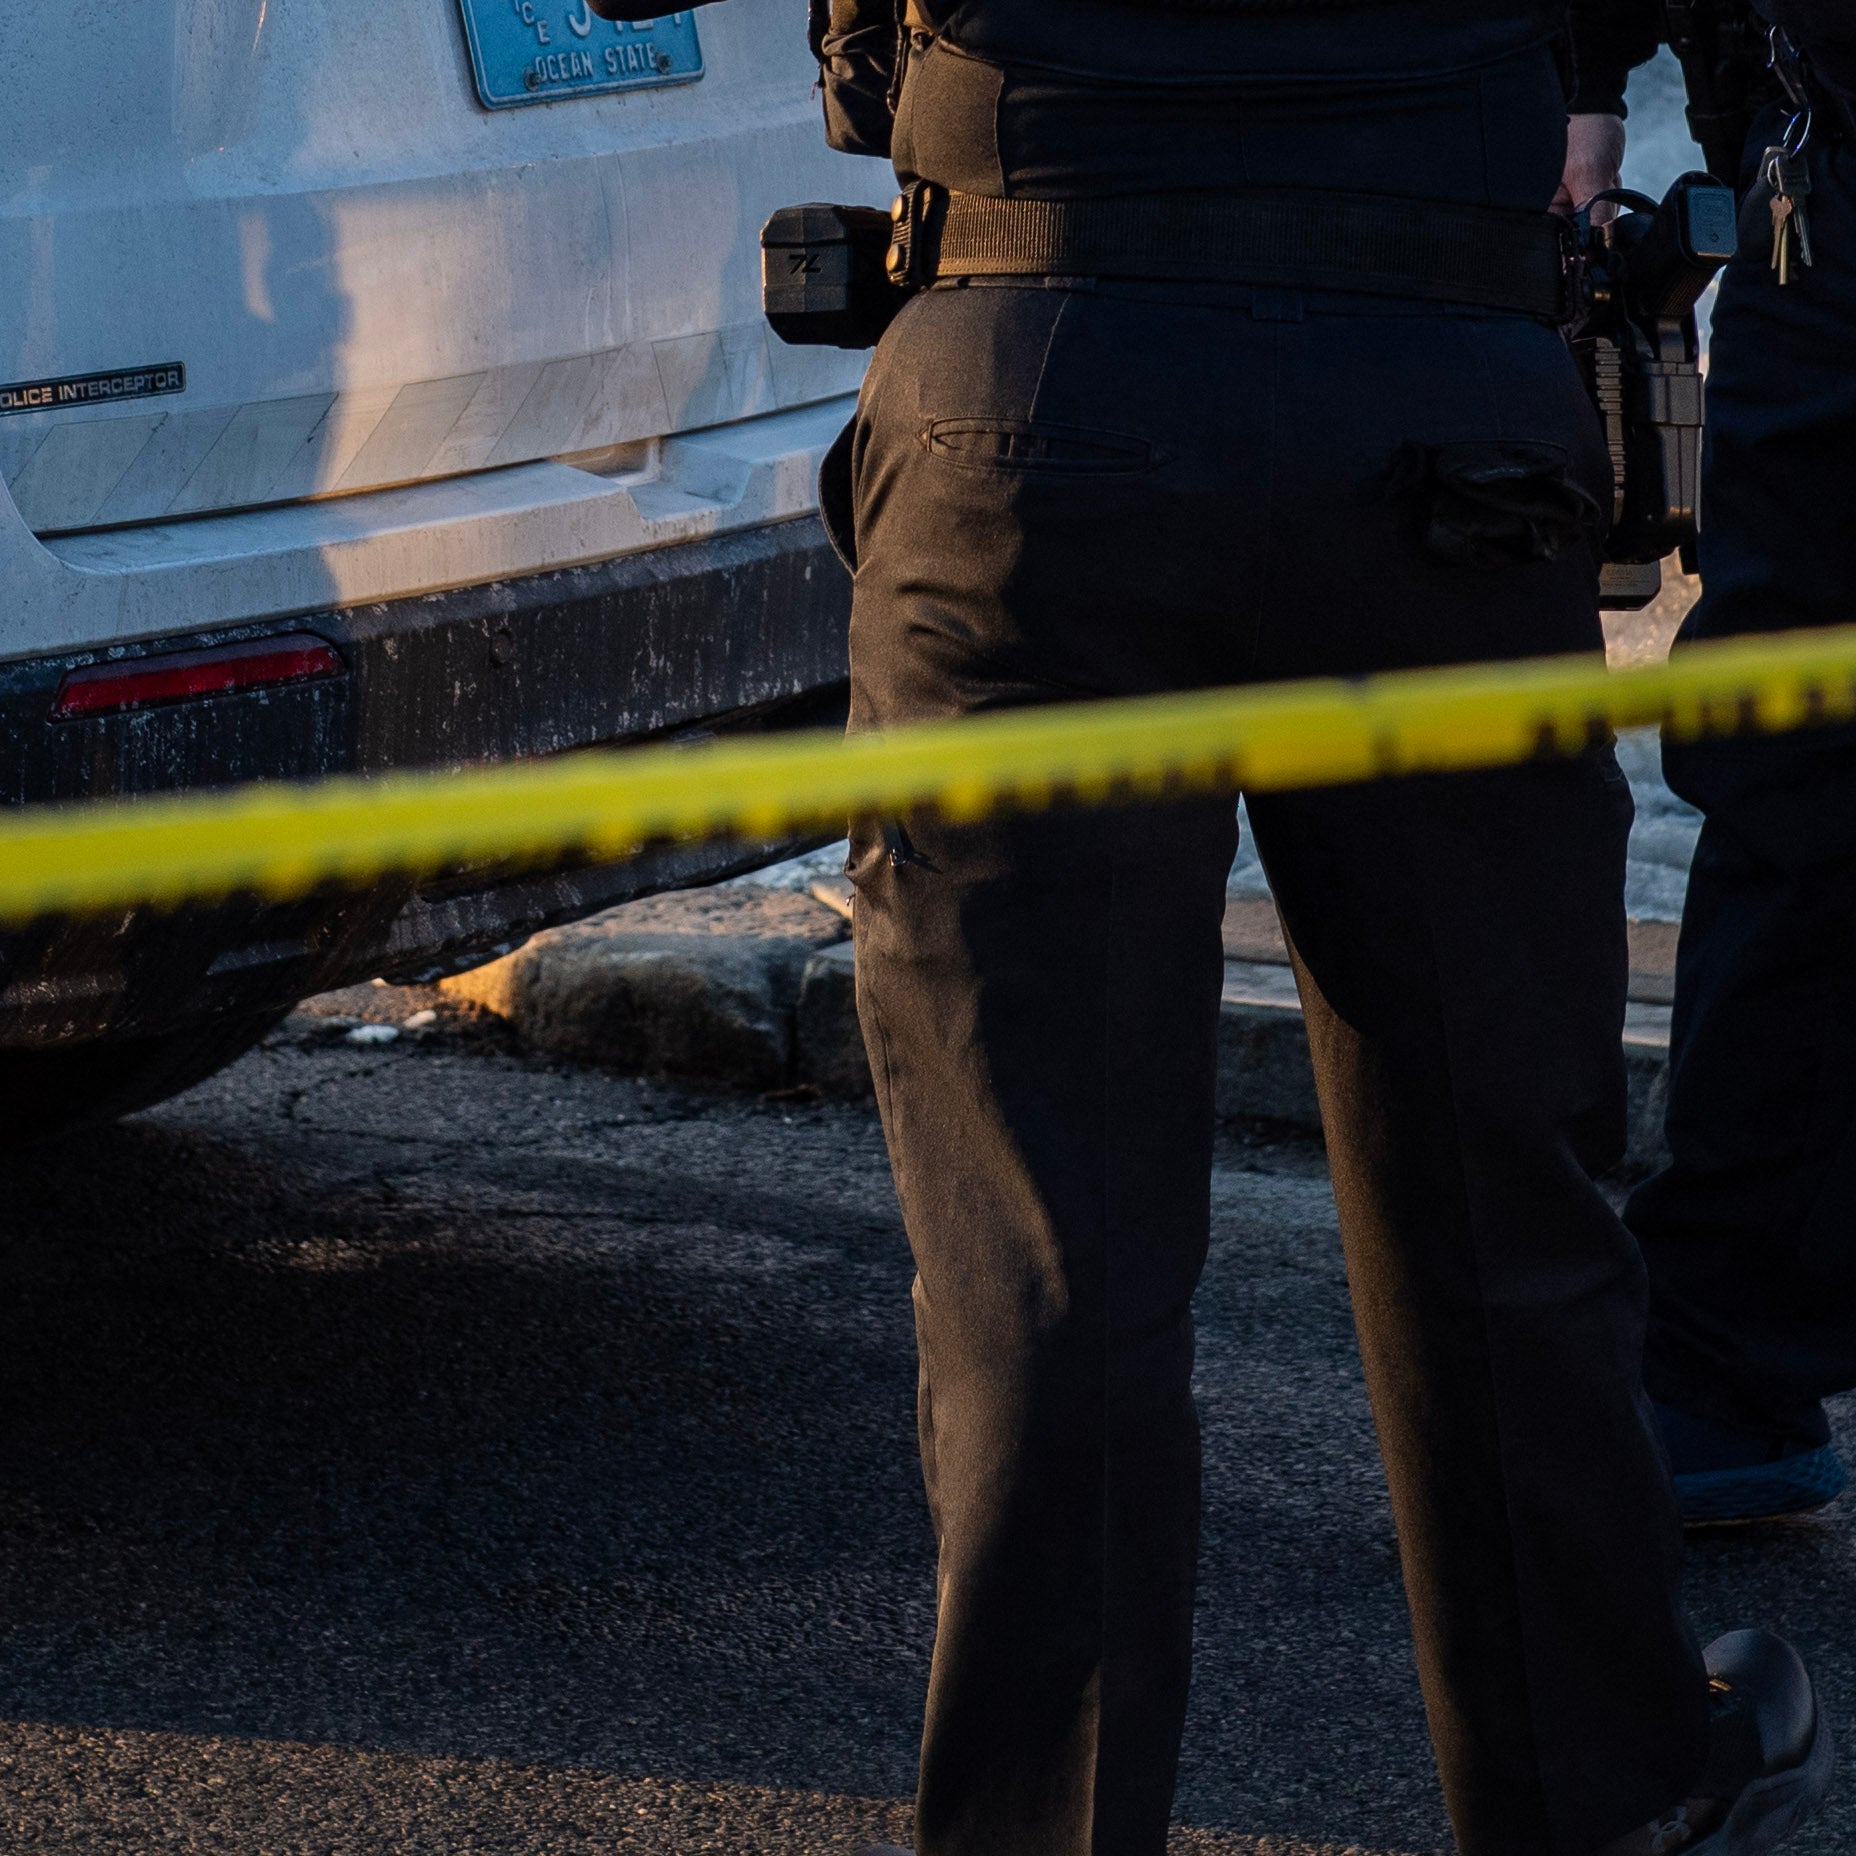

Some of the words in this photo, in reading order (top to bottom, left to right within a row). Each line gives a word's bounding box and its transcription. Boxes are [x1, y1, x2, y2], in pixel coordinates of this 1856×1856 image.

[535, 52, 594, 83] OCEAN
[605, 42, 658, 74] STATE
[58, 369, 180, 401] INTERCEPTOR
